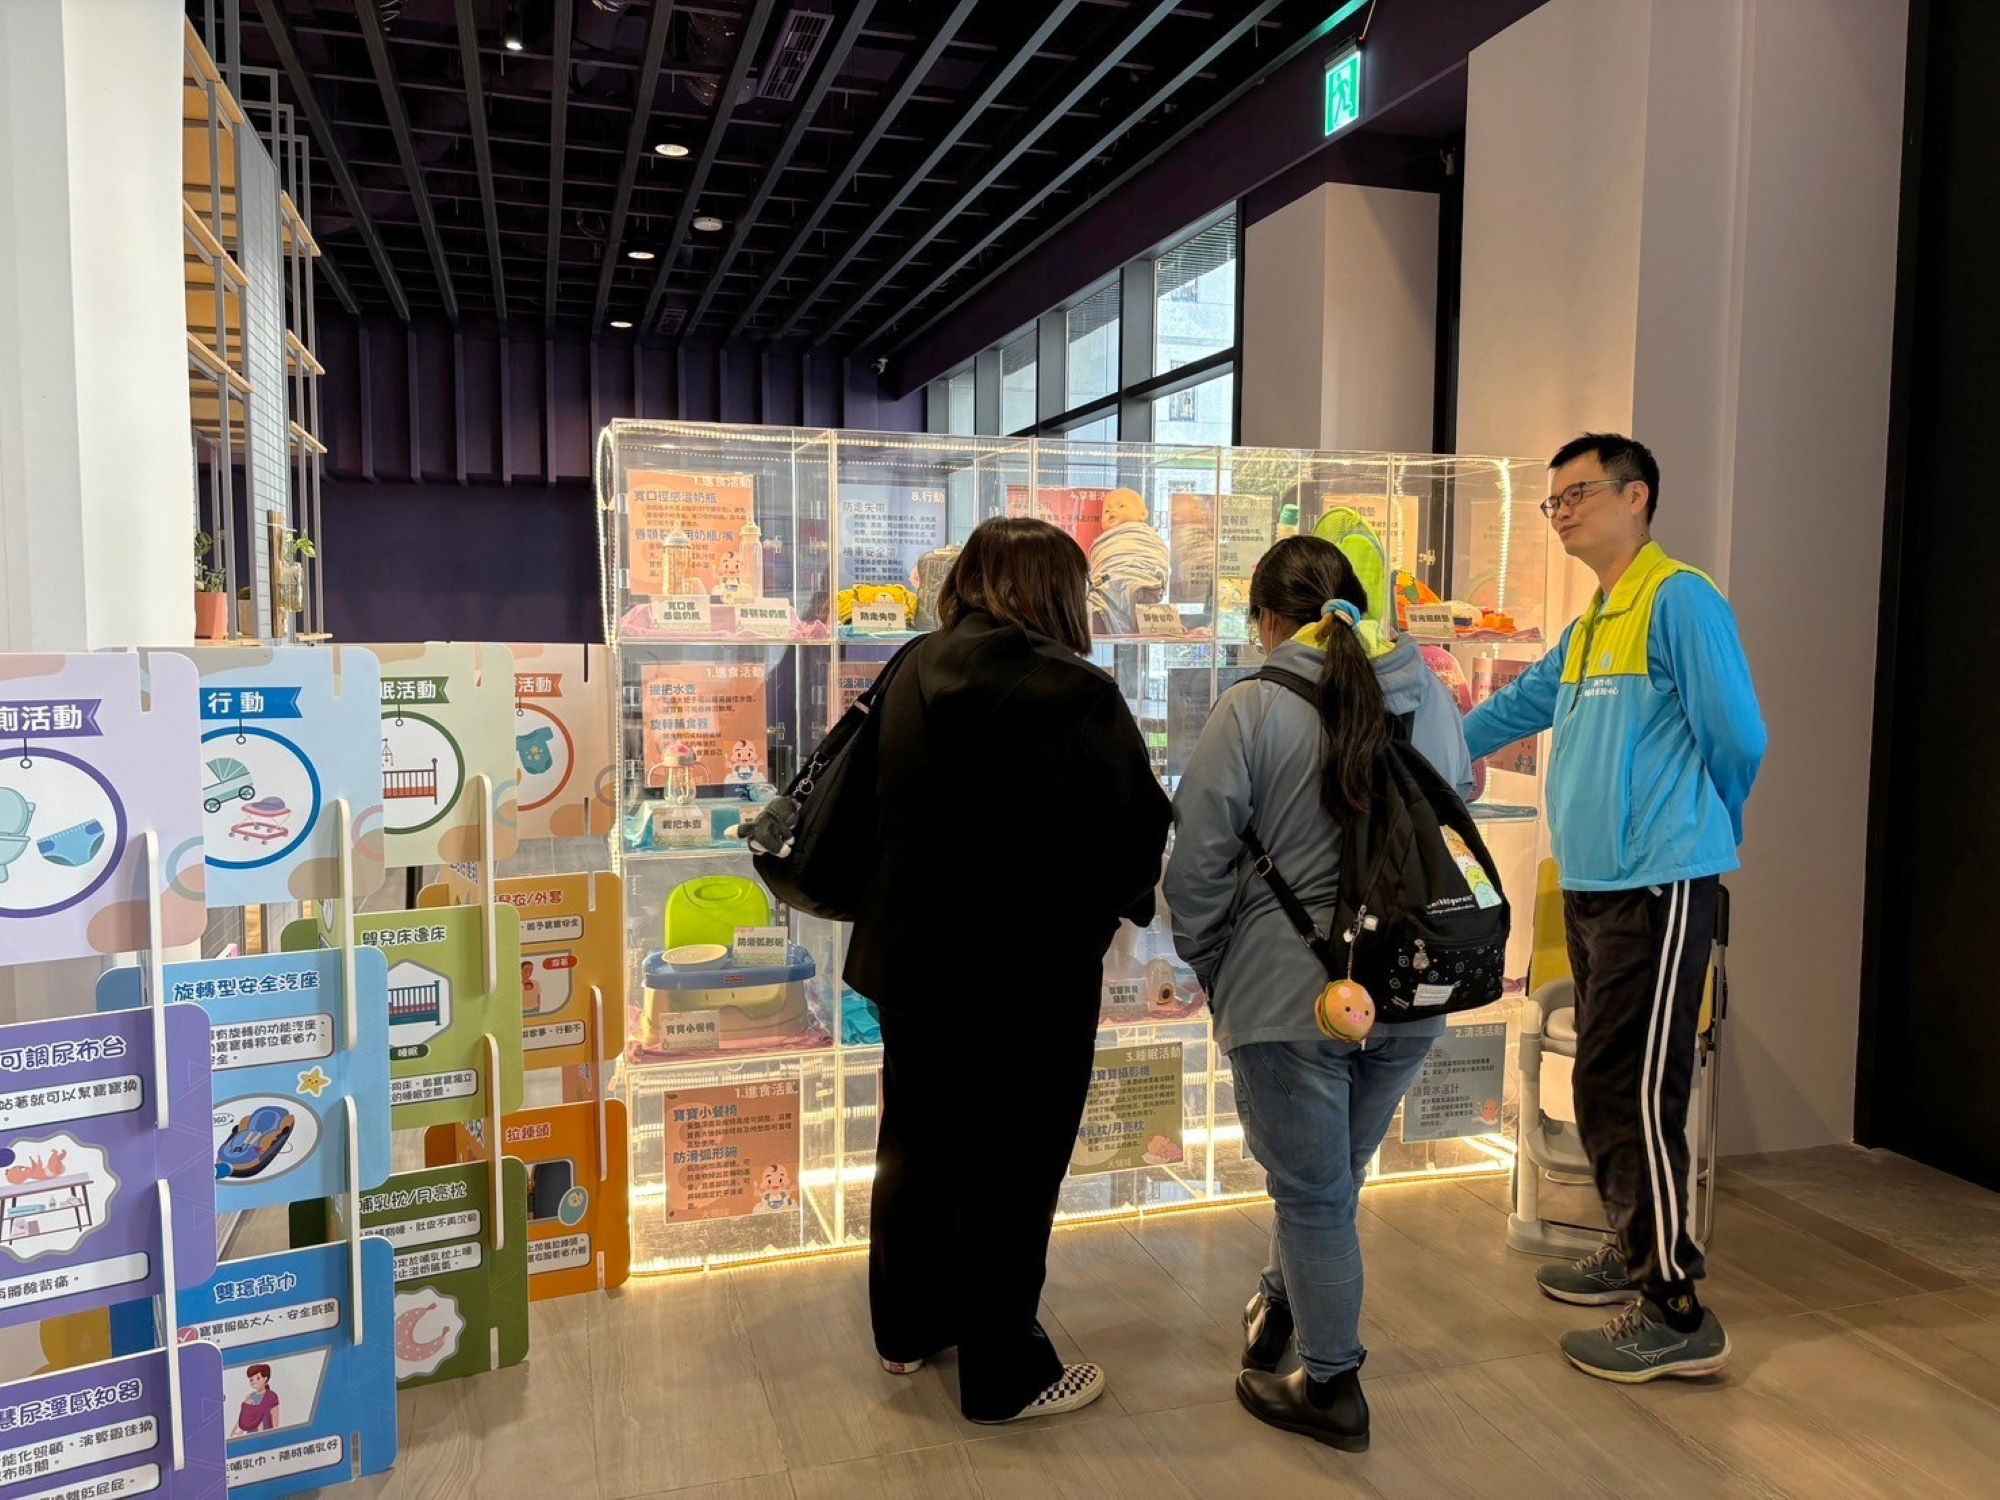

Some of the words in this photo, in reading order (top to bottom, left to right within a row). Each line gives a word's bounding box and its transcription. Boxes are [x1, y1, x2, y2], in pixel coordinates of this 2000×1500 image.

[381, 680, 437, 700] 眠活動
[515, 677, 552, 693] 活動
[208, 691, 265, 715] 行動
[173, 970, 320, 1002] 旋轉型安全汽座
[0, 1036, 127, 1071] 可調尿布台
[226, 1438, 339, 1473] 哺乳巾，隨時哺乳好
[0, 1457, 60, 1481] 布時間。
